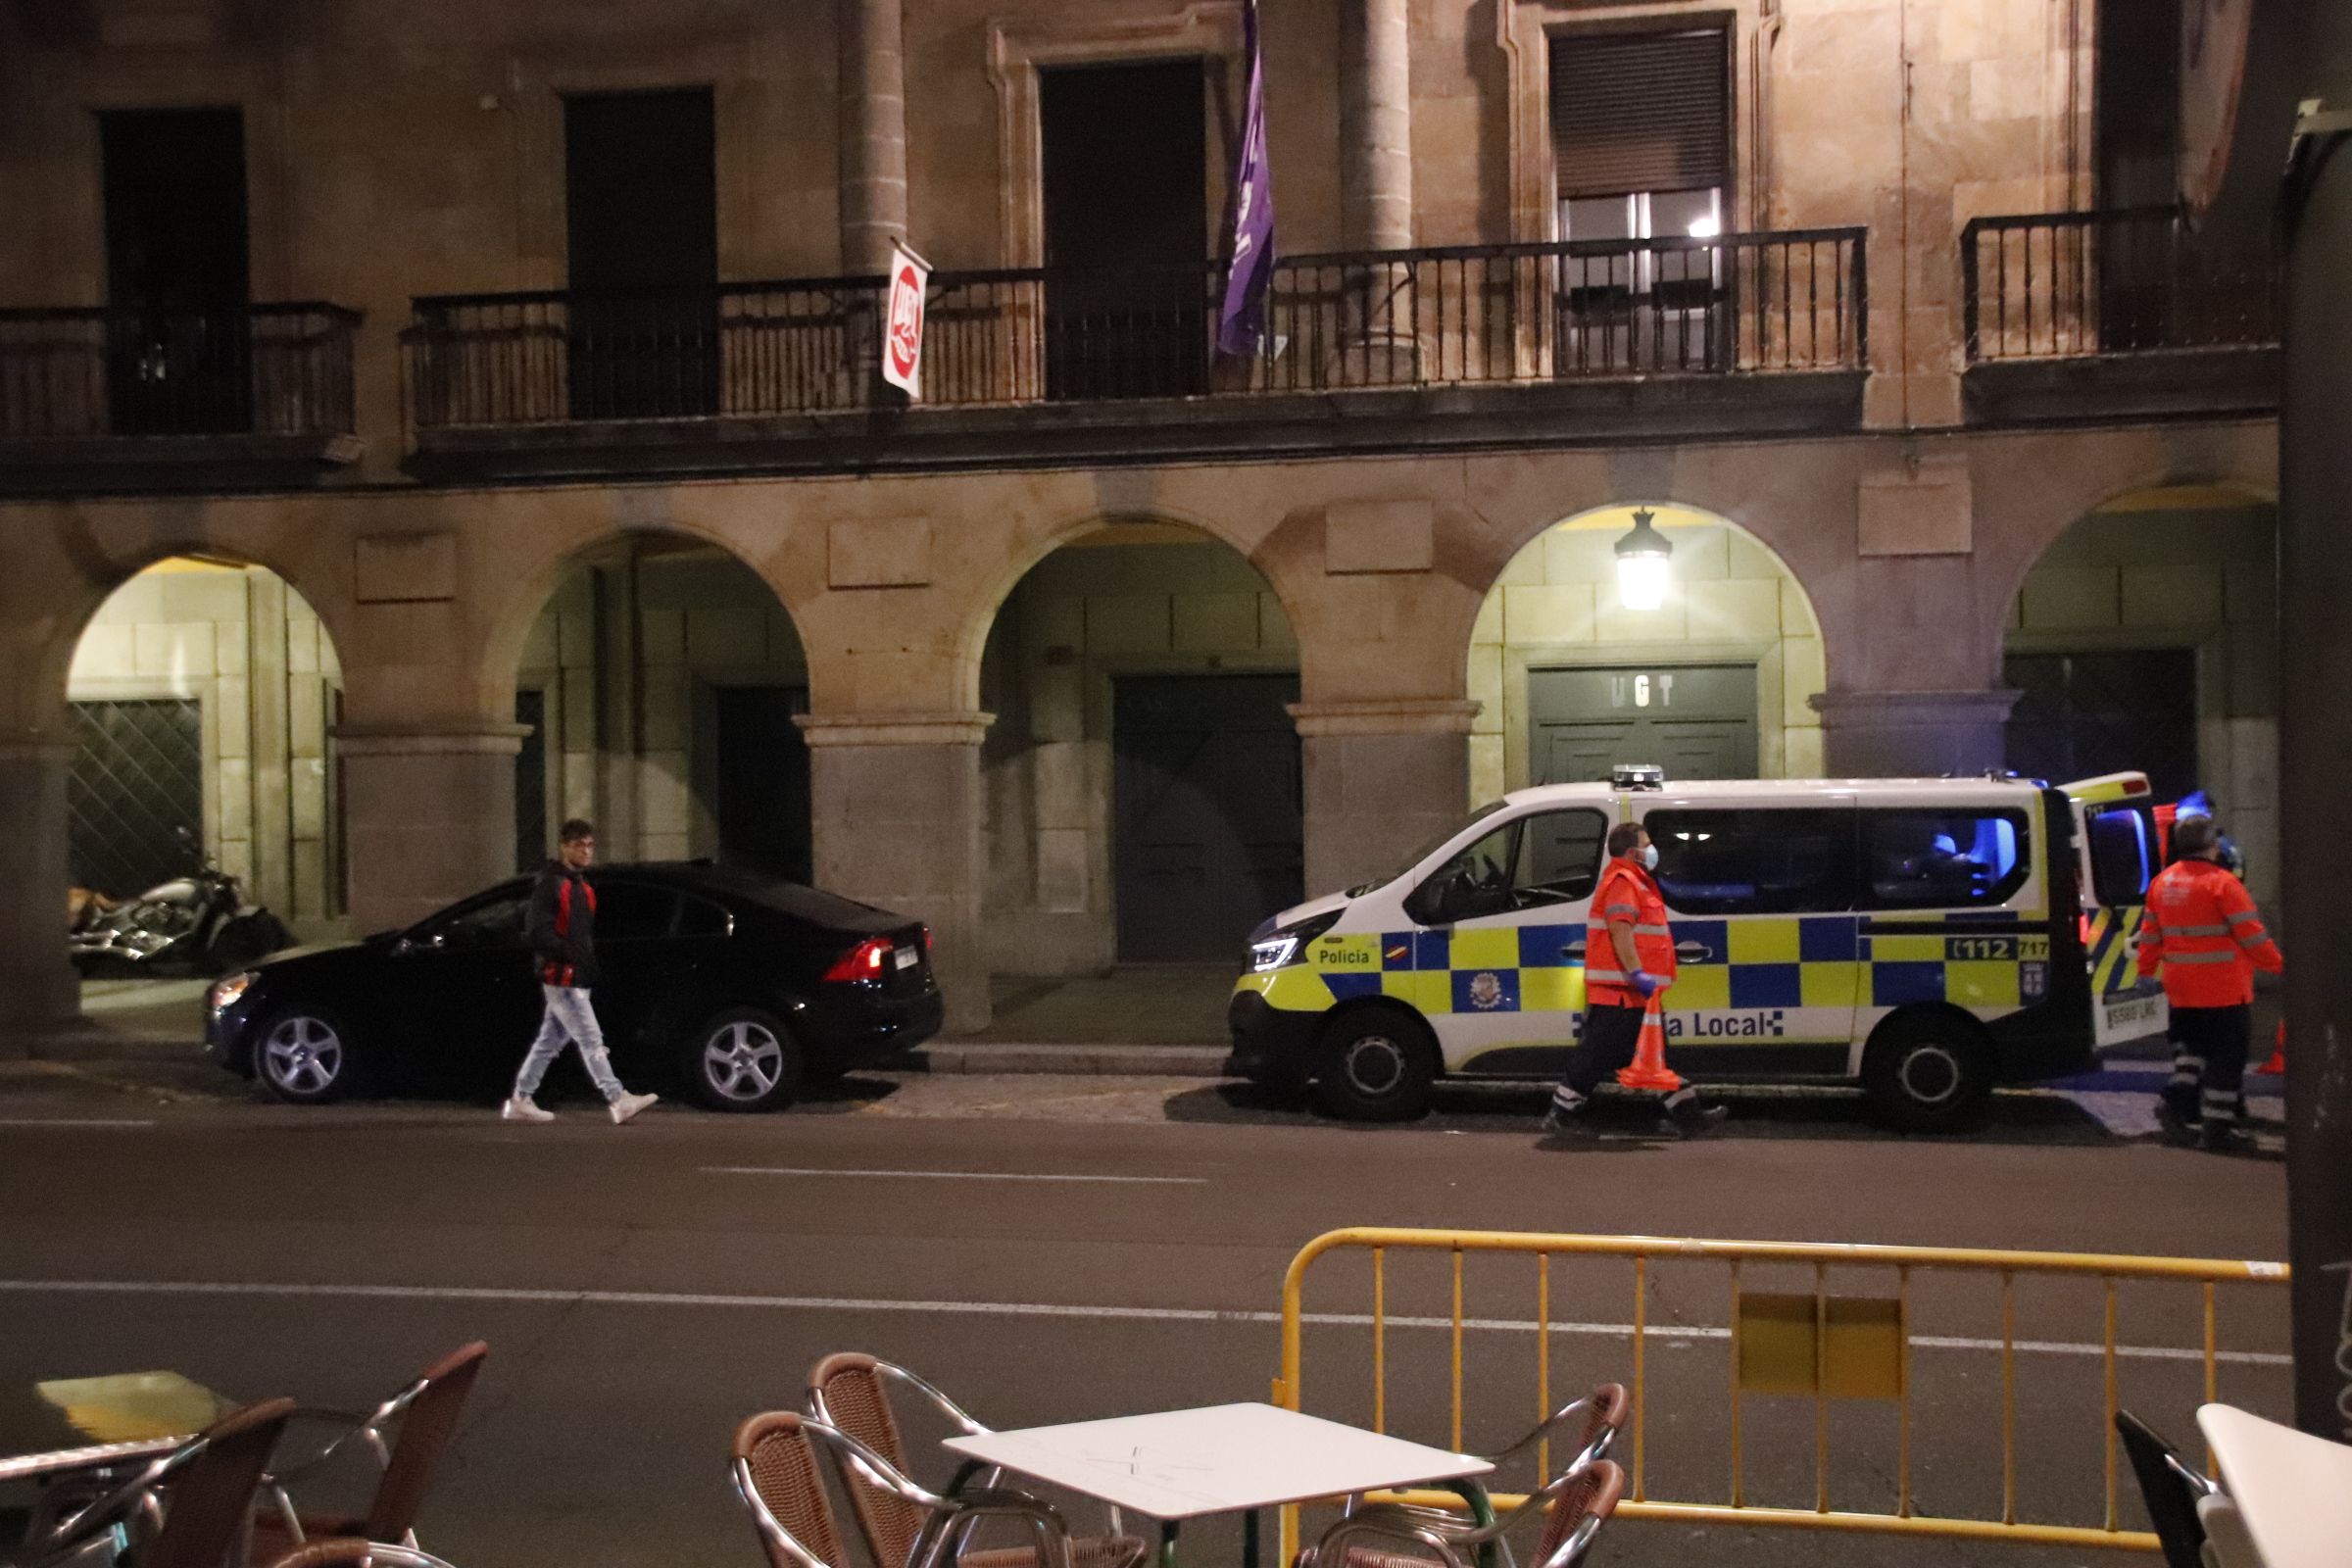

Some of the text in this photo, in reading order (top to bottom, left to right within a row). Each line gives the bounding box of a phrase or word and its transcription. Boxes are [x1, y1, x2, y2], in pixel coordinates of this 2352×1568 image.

[1611, 674, 1673, 707] UGT
[1962, 939, 2009, 958] 112
[2020, 942, 2048, 956] 717
[1694, 1011, 1765, 1037] Local
